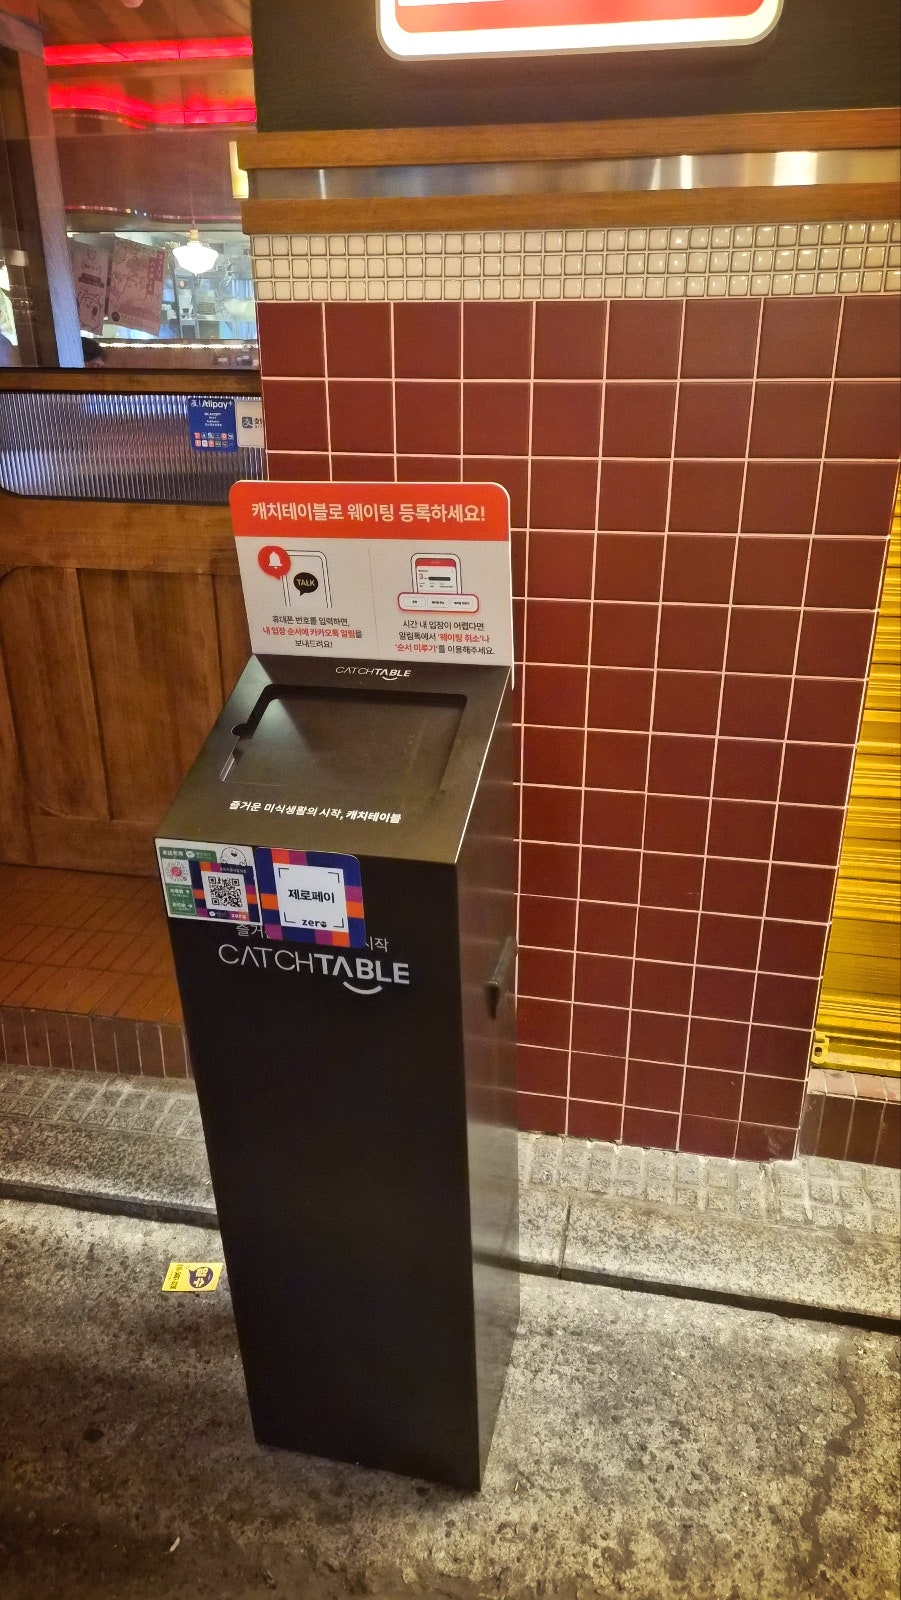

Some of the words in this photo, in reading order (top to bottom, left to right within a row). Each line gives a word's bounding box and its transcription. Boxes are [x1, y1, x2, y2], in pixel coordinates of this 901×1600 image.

[251, 501, 344, 522] 캐치테이블로
[347, 503, 394, 522] 웨이팅
[399, 504, 486, 523] 등록하세요!
[296, 578, 315, 587] TALK
[272, 615, 294, 625] 휴대폰
[295, 616, 317, 626] 번호를
[318, 617, 350, 628] 입력하면,
[402, 619, 418, 629] 시간
[419, 620, 427, 629] 내
[428, 621, 452, 630] 입장이
[453, 622, 485, 631] 어렵다면
[263, 626, 271, 635] 내
[271, 627, 286, 636] 입장
[287, 628, 309, 637] 순서에
[310, 628, 340, 638] 카카오톡
[340, 629, 363, 639] 알림을
[398, 631, 437, 641] 알림톡에서
[295, 640, 333, 649] 보내드려요!
[447, 645, 496, 655] 이용해주세요.
[335, 666, 412, 677] CATCHTABLE
[229, 800, 262, 812] 즐거운
[263, 802, 318, 817] 미식생활의
[319, 808, 345, 821] 시작,
[345, 809, 402, 824] 캐치테이블
[287, 888, 336, 904] 제로페이
[235, 924, 265, 939] 즐거
[218, 943, 410, 985] CATCHTABLE
